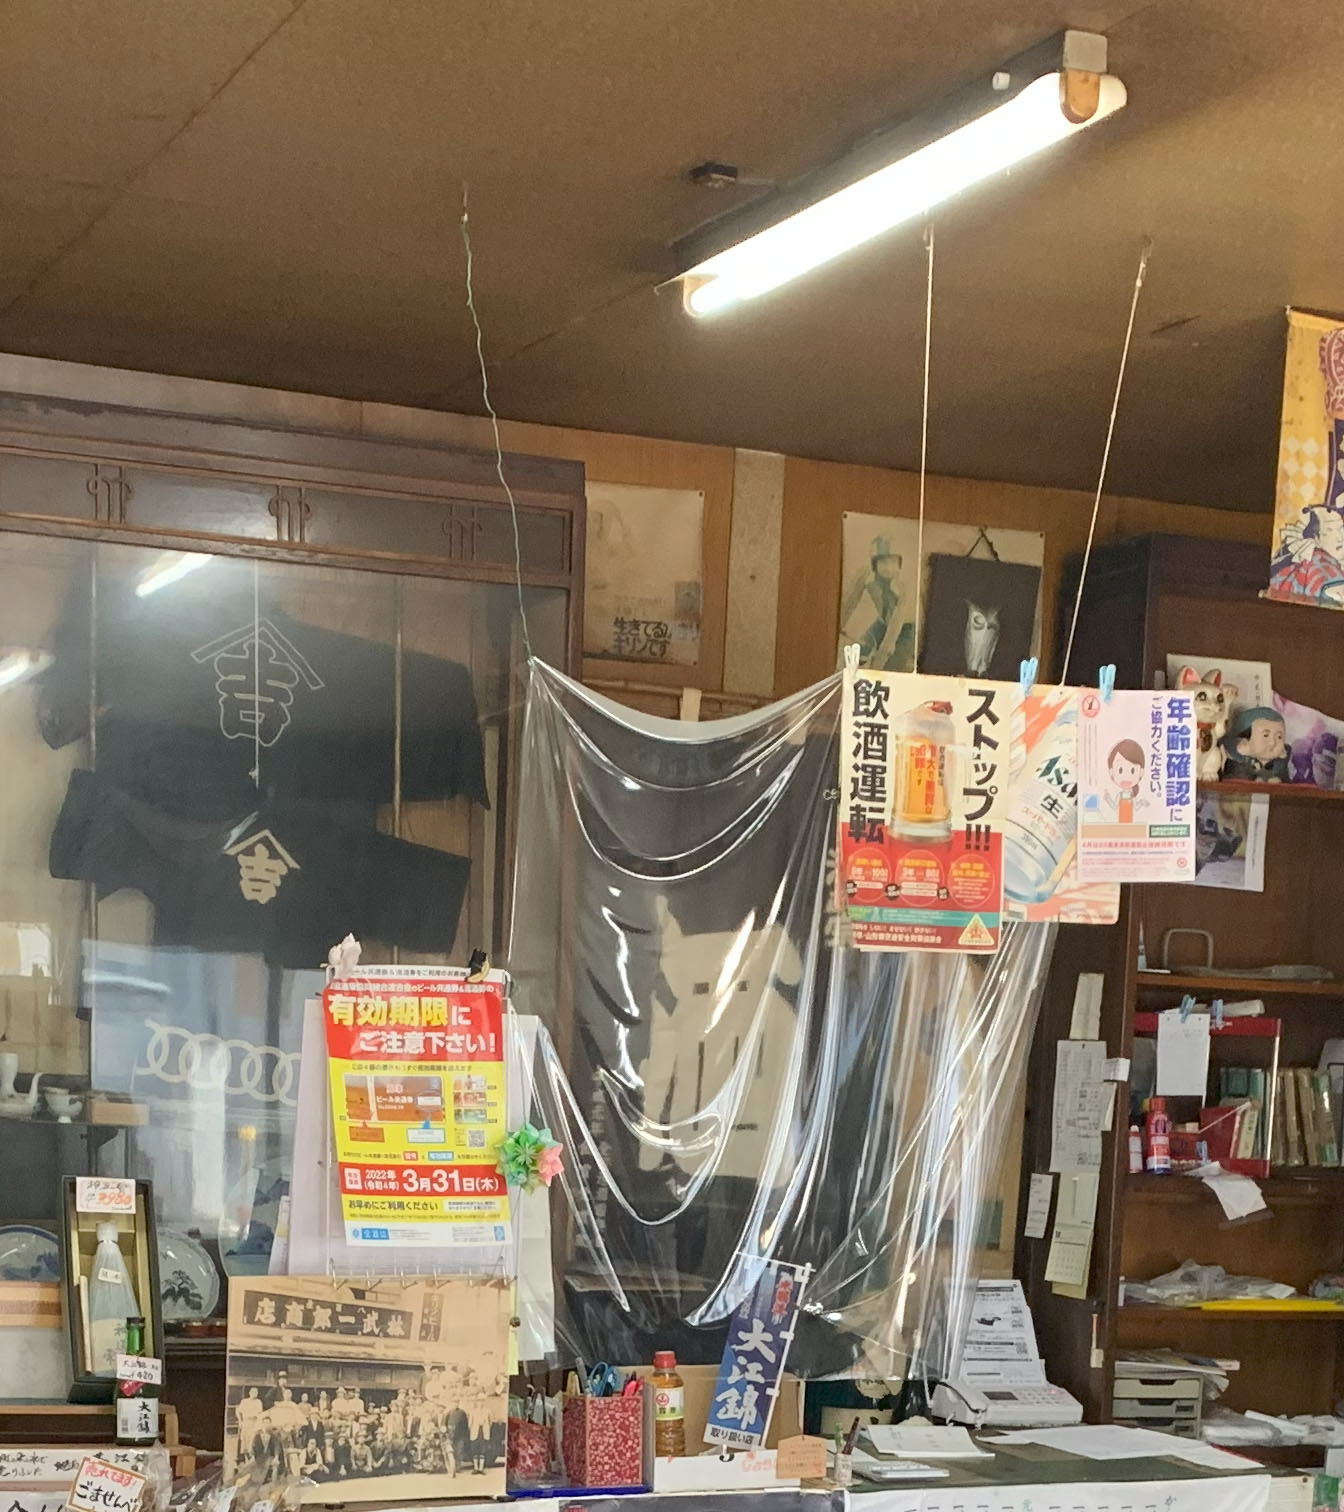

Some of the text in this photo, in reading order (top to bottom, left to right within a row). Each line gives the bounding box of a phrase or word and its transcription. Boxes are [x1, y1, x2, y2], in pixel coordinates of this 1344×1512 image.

[847, 677, 891, 846] 飲酒運転
[1036, 754, 1078, 807] Asa
[1164, 696, 1194, 822] 年齢確認に
[1040, 794, 1064, 820] 生
[327, 992, 472, 1028] 有効期限に
[402, 1168, 500, 1193] 3月31日(木)
[715, 1317, 777, 1431] 大江錦
[710, 1426, 755, 1445] 取り扱い店
